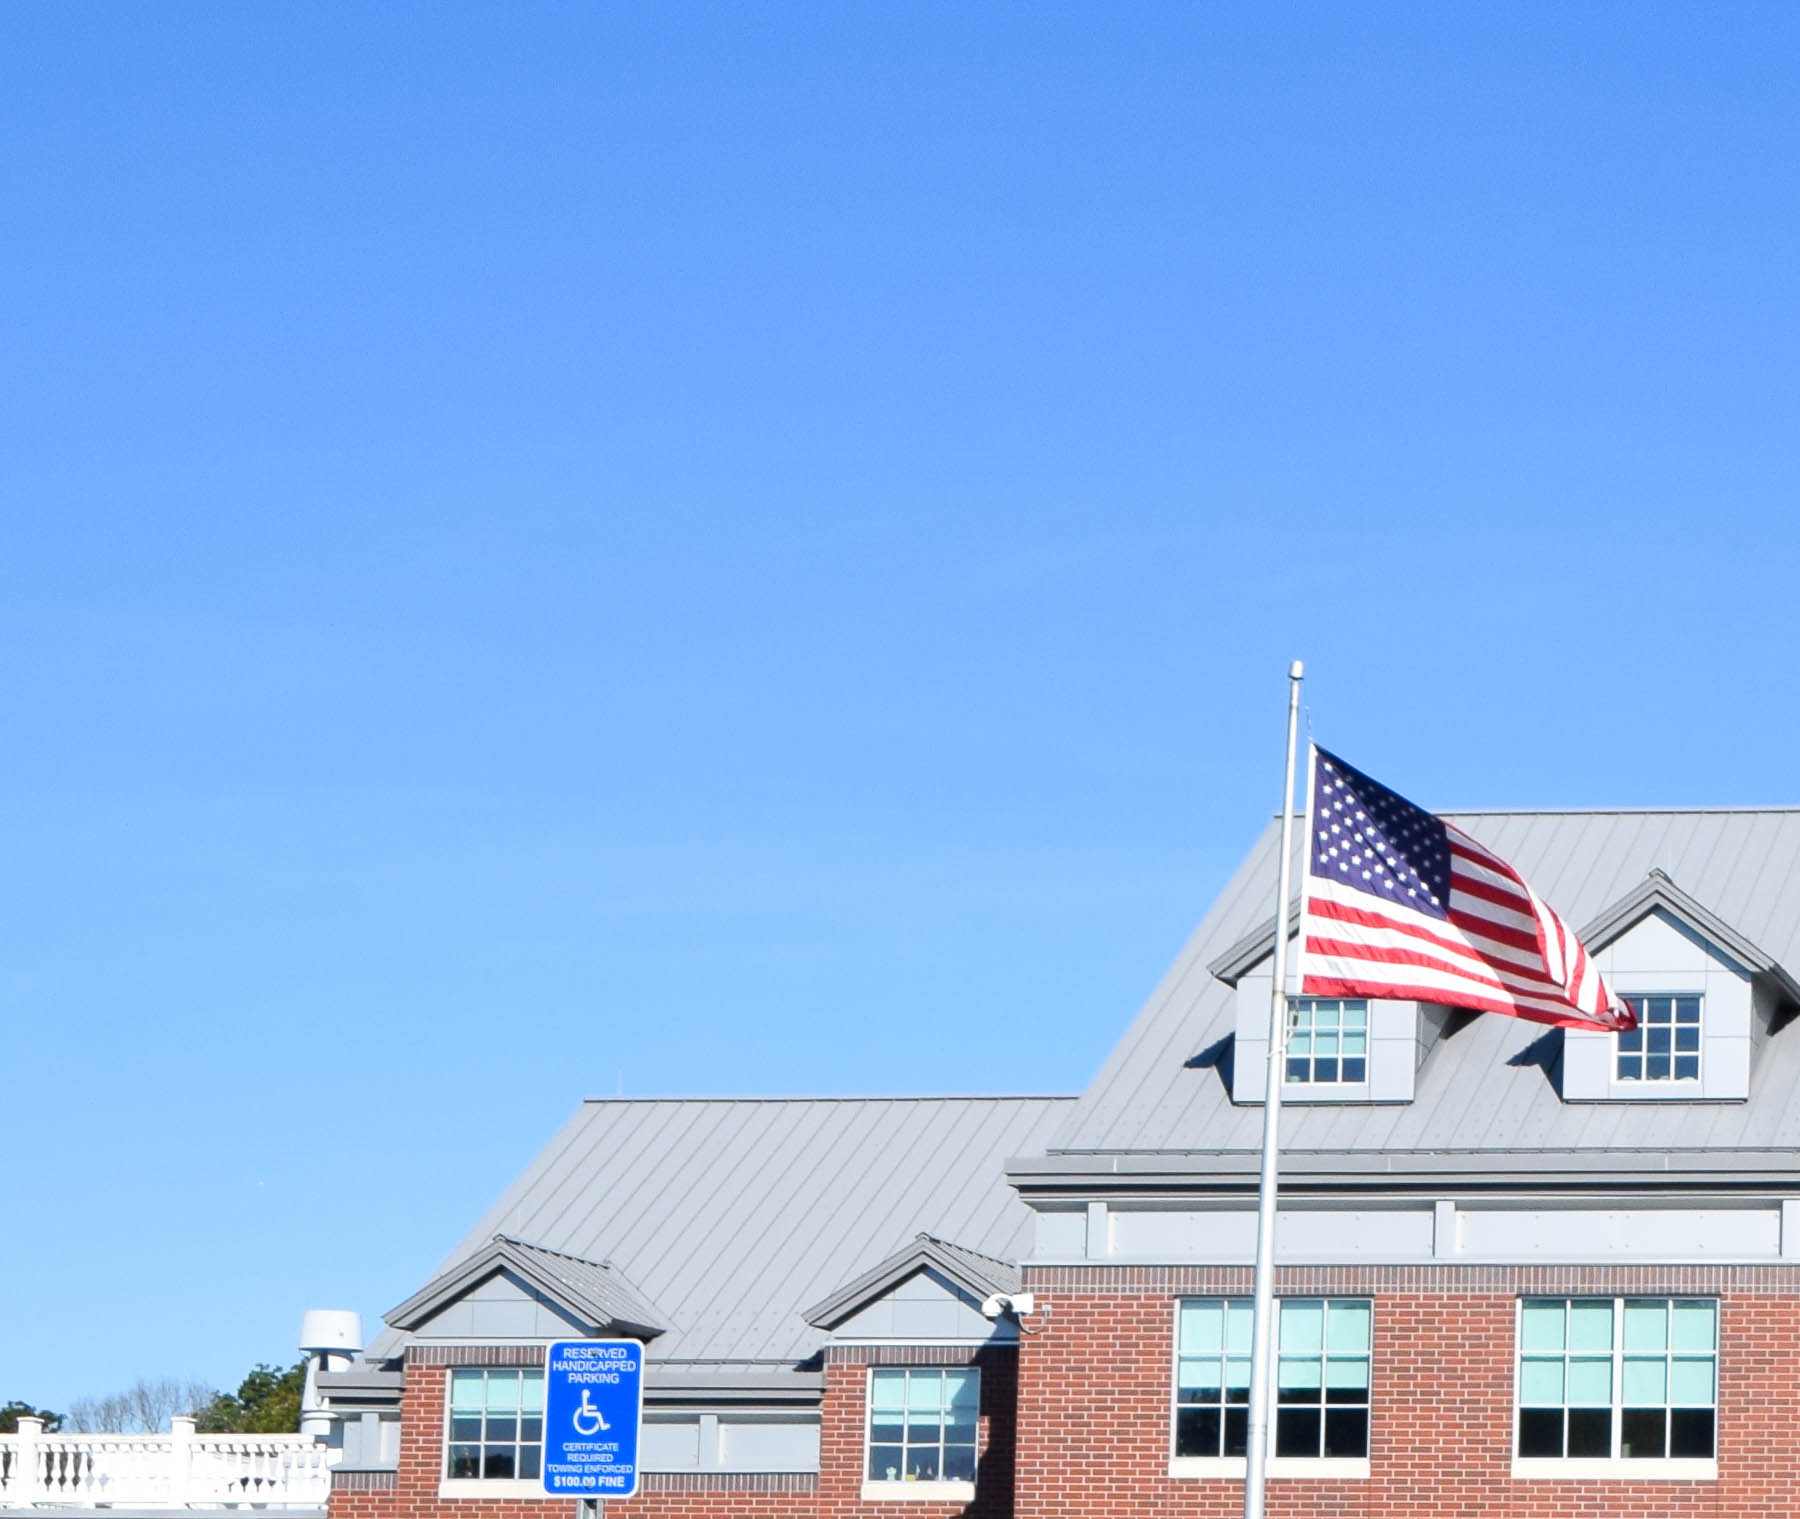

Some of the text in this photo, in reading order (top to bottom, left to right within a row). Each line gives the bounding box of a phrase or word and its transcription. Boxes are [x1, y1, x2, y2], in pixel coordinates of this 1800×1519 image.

[563, 1348, 627, 1358] RESERVED
[553, 1361, 636, 1371] HANDICAPPED
[568, 1373, 619, 1383] PARKING
[563, 1443, 619, 1452] CERTIFICATE
[567, 1454, 613, 1462] REQUIRED
[547, 1464, 633, 1473] TOWING ENFORCED
[598, 1477, 624, 1487] FINE
